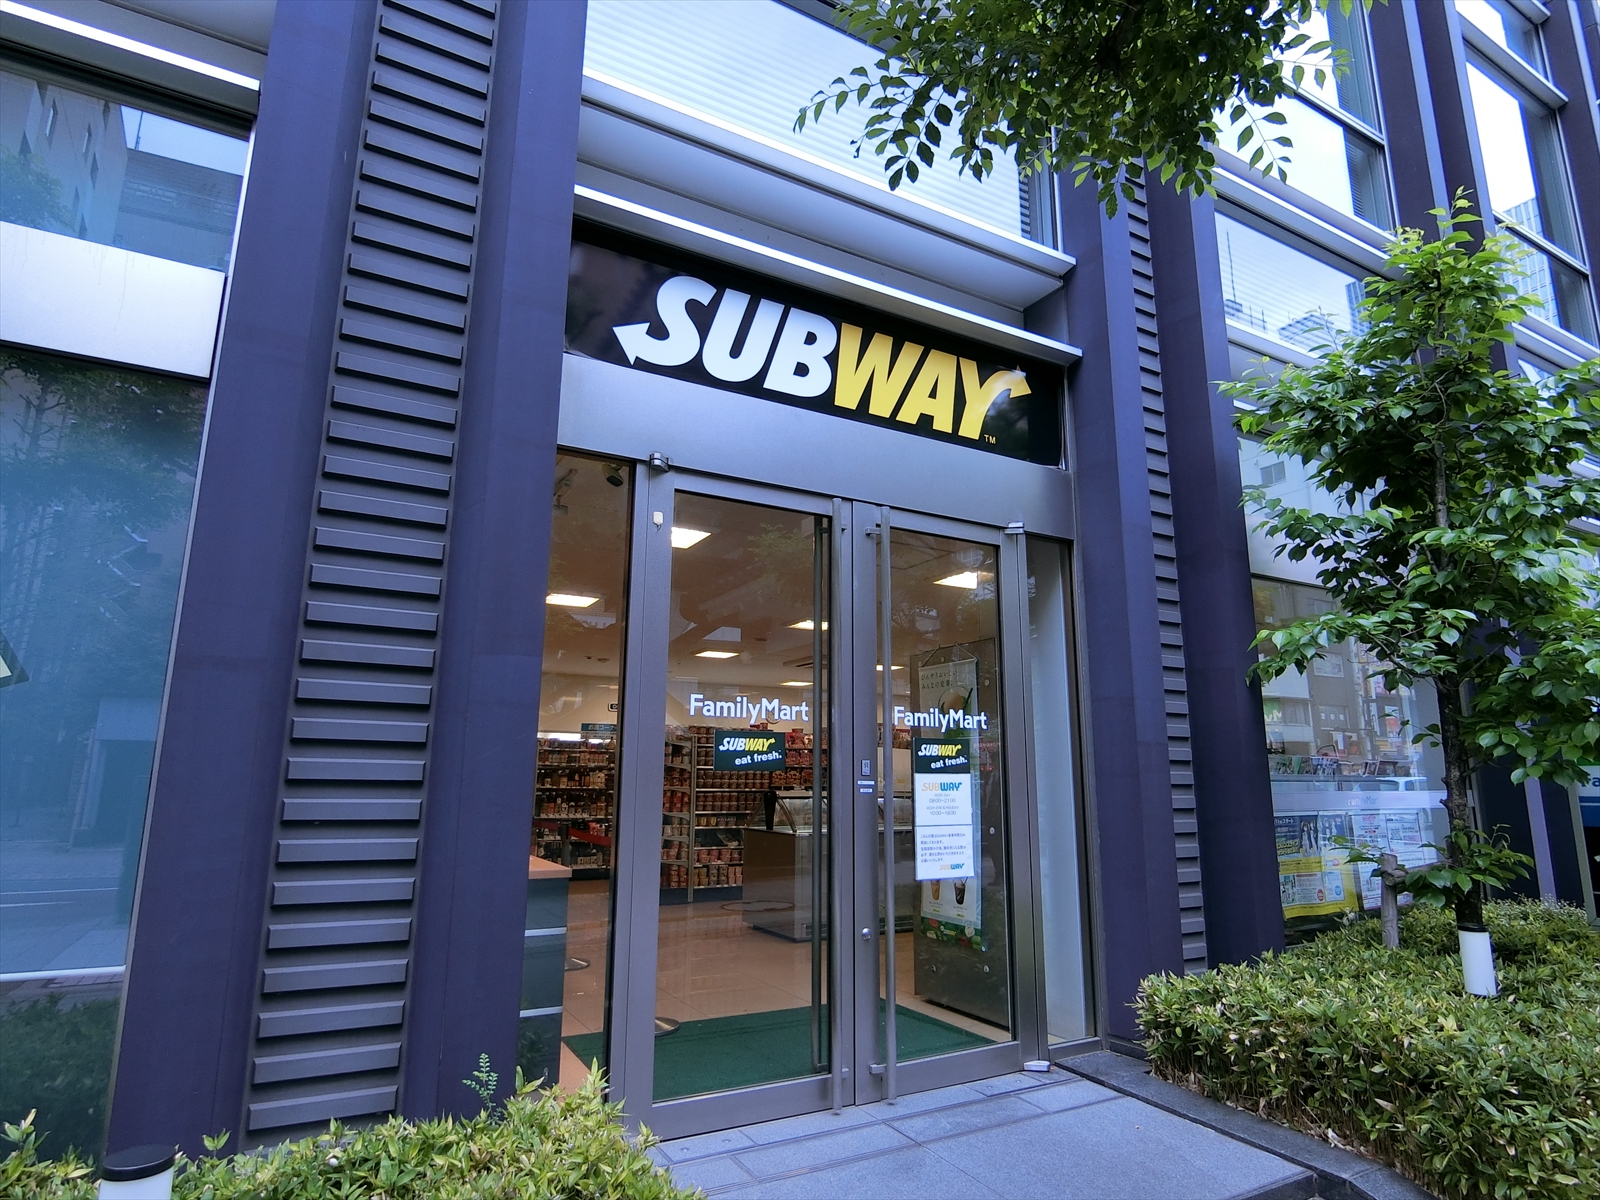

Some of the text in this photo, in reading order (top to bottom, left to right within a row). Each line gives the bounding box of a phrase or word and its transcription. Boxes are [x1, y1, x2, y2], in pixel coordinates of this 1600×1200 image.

[612, 275, 1032, 441] SUBWAY
[689, 693, 809, 725] FamilyMart
[893, 706, 988, 733] FamilyMart
[718, 737, 776, 752] SUBWAY
[918, 743, 962, 757] SUBWAY
[735, 755, 752, 766] eat
[930, 758, 944, 769] eat
[921, 781, 962, 792] SUBWAY
